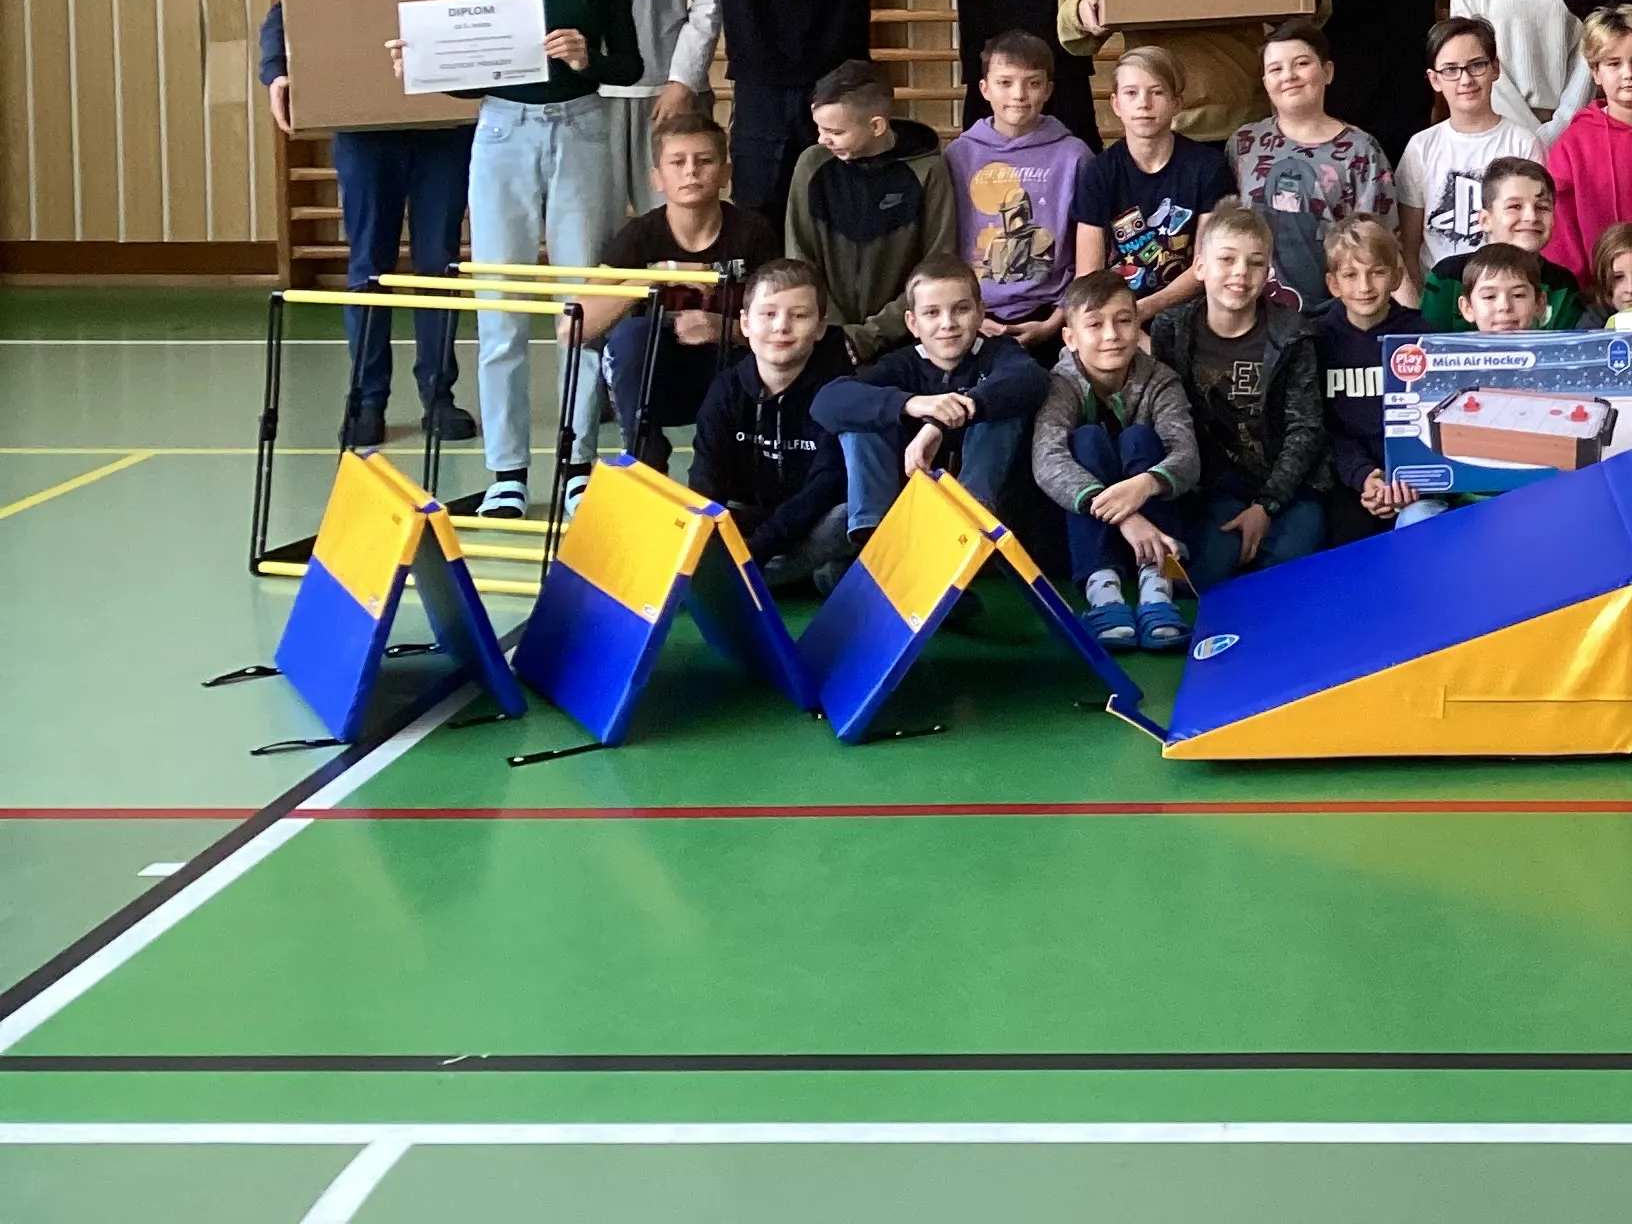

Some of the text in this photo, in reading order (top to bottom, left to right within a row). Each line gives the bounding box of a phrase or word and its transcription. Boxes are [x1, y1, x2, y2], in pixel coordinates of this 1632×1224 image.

[448, 5, 496, 17] DIPLOM
[1396, 354, 1423, 365] Play
[1432, 355, 1529, 367] Mini Air Hockey
[1397, 363, 1422, 373] tive
[1327, 367, 1384, 398] PUM
